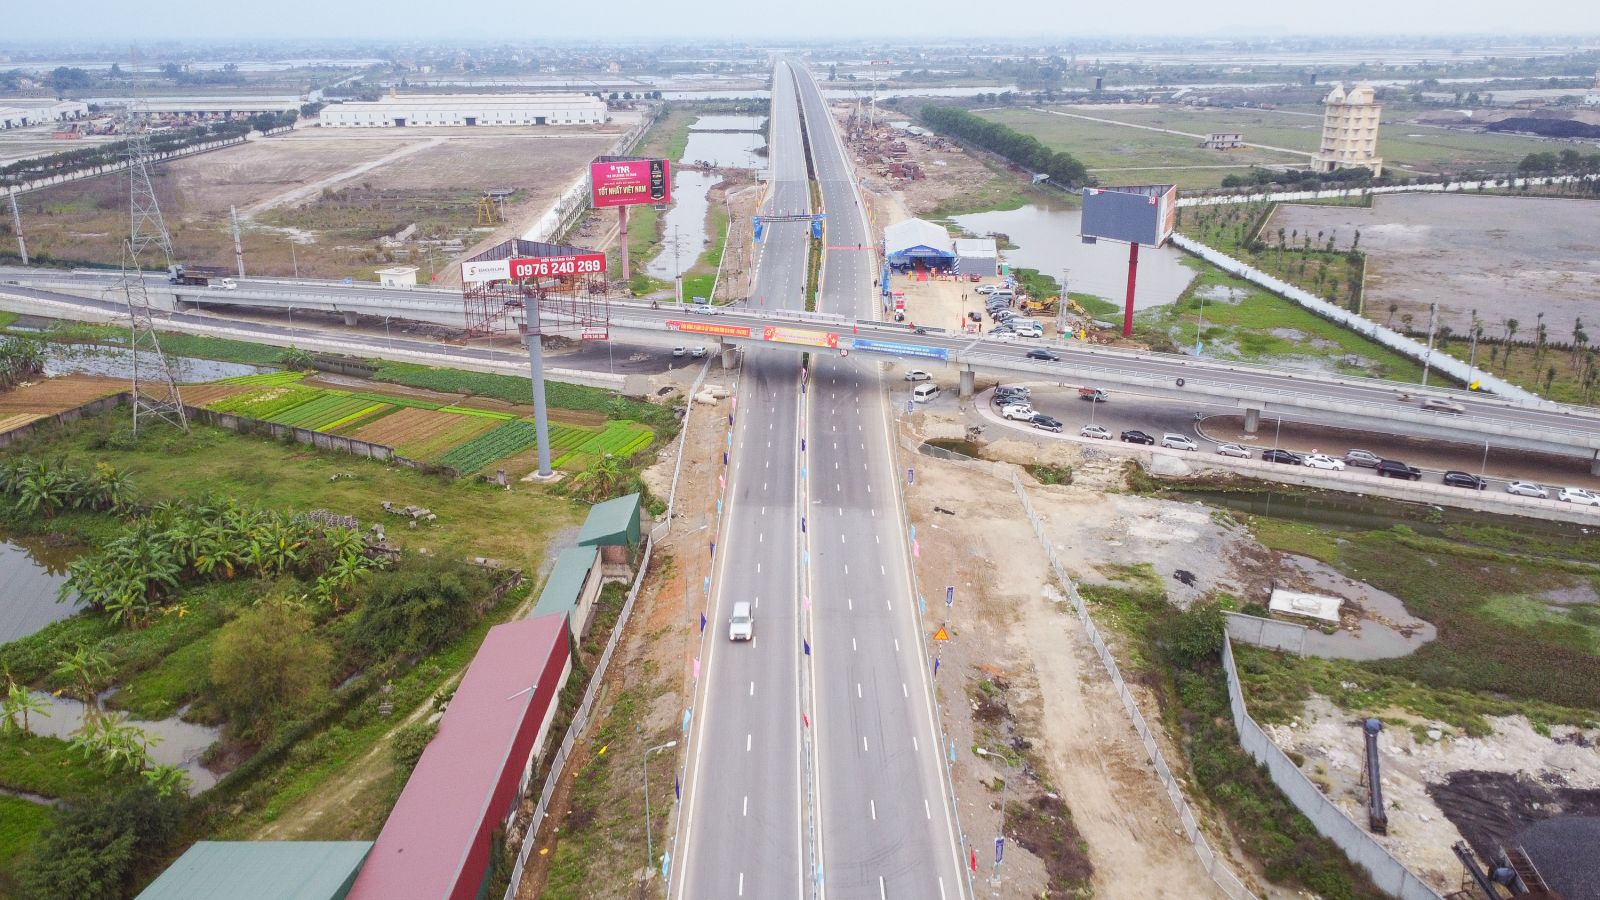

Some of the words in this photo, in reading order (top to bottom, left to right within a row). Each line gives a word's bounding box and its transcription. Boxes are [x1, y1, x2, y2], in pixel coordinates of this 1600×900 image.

[616, 165, 630, 173] TNR
[634, 185, 647, 193] NAM
[516, 262, 548, 277] 0976
[551, 261, 574, 275] 240
[577, 259, 600, 272] 269
